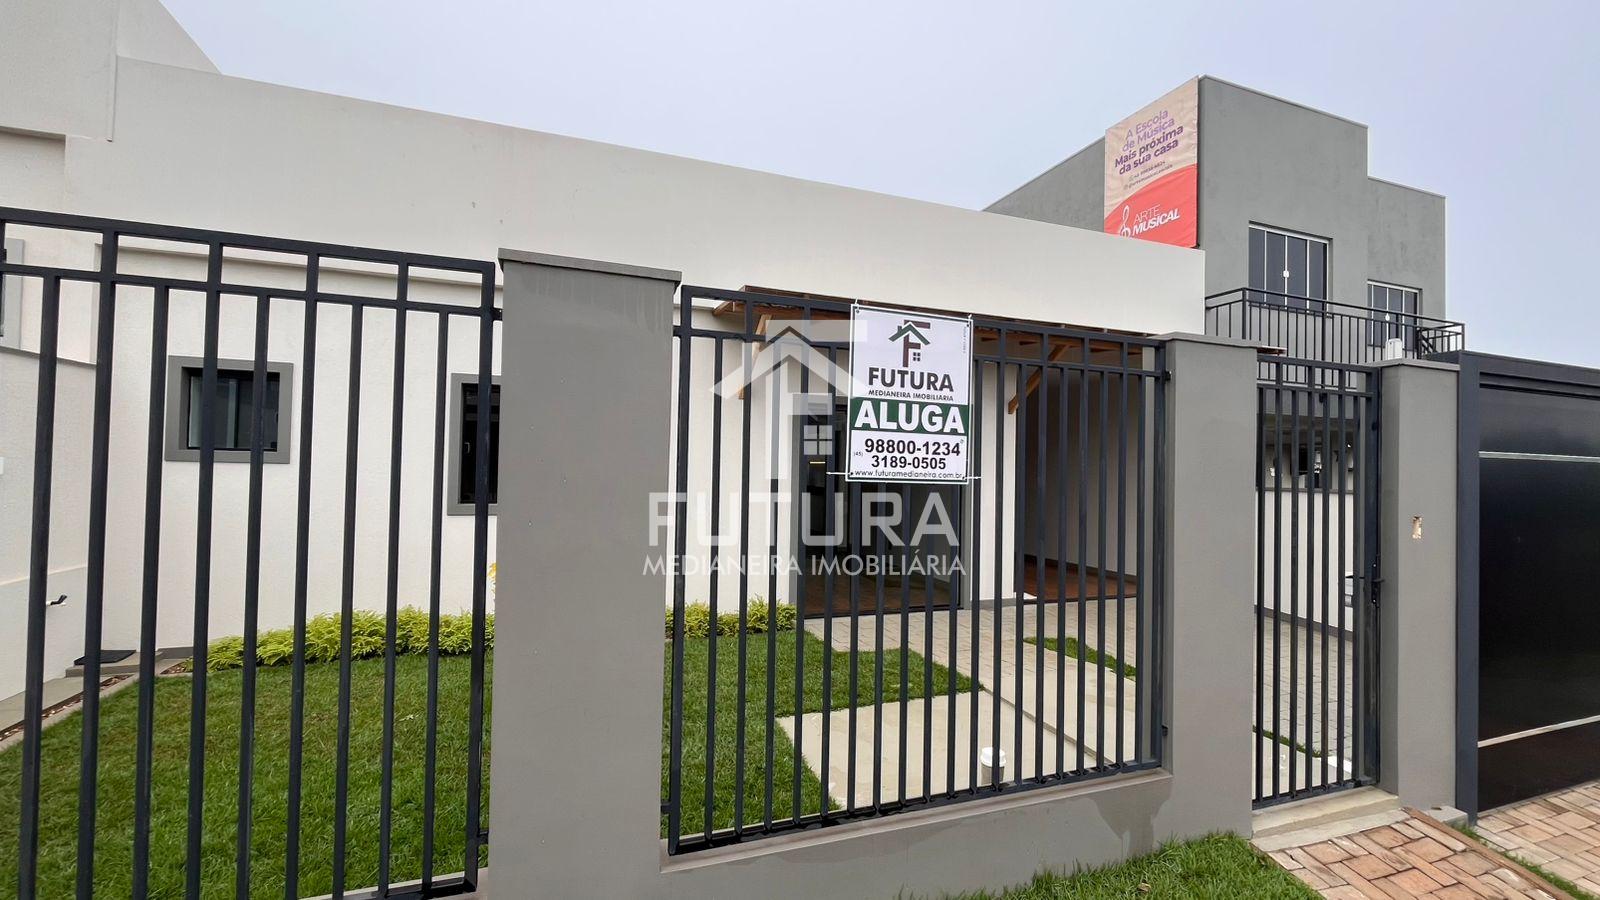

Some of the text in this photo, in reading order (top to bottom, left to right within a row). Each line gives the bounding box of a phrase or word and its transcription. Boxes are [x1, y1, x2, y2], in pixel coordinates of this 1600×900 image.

[1122, 118, 1175, 152] de Música
[1126, 110, 1168, 140] A Escola
[1115, 126, 1184, 168] Mais próxima
[1119, 163, 1131, 175] da
[1133, 153, 1151, 169] sua
[1154, 139, 1179, 157] casa
[1133, 204, 1161, 225] ARTE
[1133, 208, 1180, 236] MUSICAL
[868, 367, 954, 392] FUTURA
[868, 390, 911, 399] MEDIANEIRA
[854, 400, 965, 434] ALUGA
[864, 438, 961, 456] 98800-1234
[855, 469, 962, 479] www.futuramedianeira.com.br
[871, 455, 946, 470] 3189-0505
